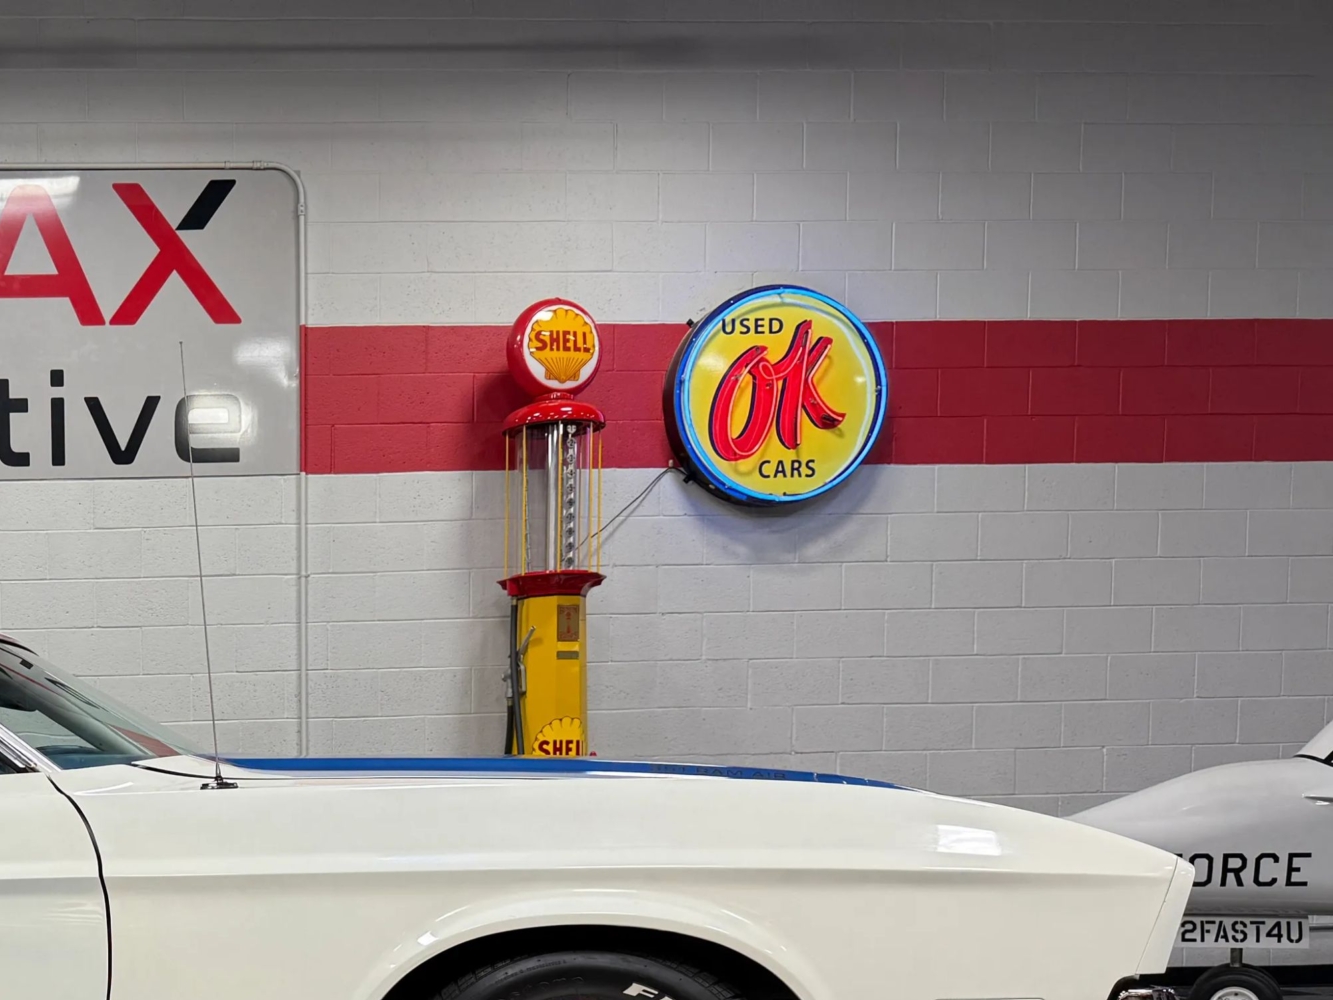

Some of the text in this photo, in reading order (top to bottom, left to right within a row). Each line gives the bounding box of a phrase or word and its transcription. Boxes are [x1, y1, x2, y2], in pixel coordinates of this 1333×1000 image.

[721, 317, 784, 335] USED
[534, 330, 591, 353] SHELL
[708, 319, 847, 463] OK
[758, 459, 816, 479] CARS
[538, 739, 584, 756] SHEL
[1174, 852, 1312, 887] ORCE
[1180, 920, 1303, 944] 2FAST4U
